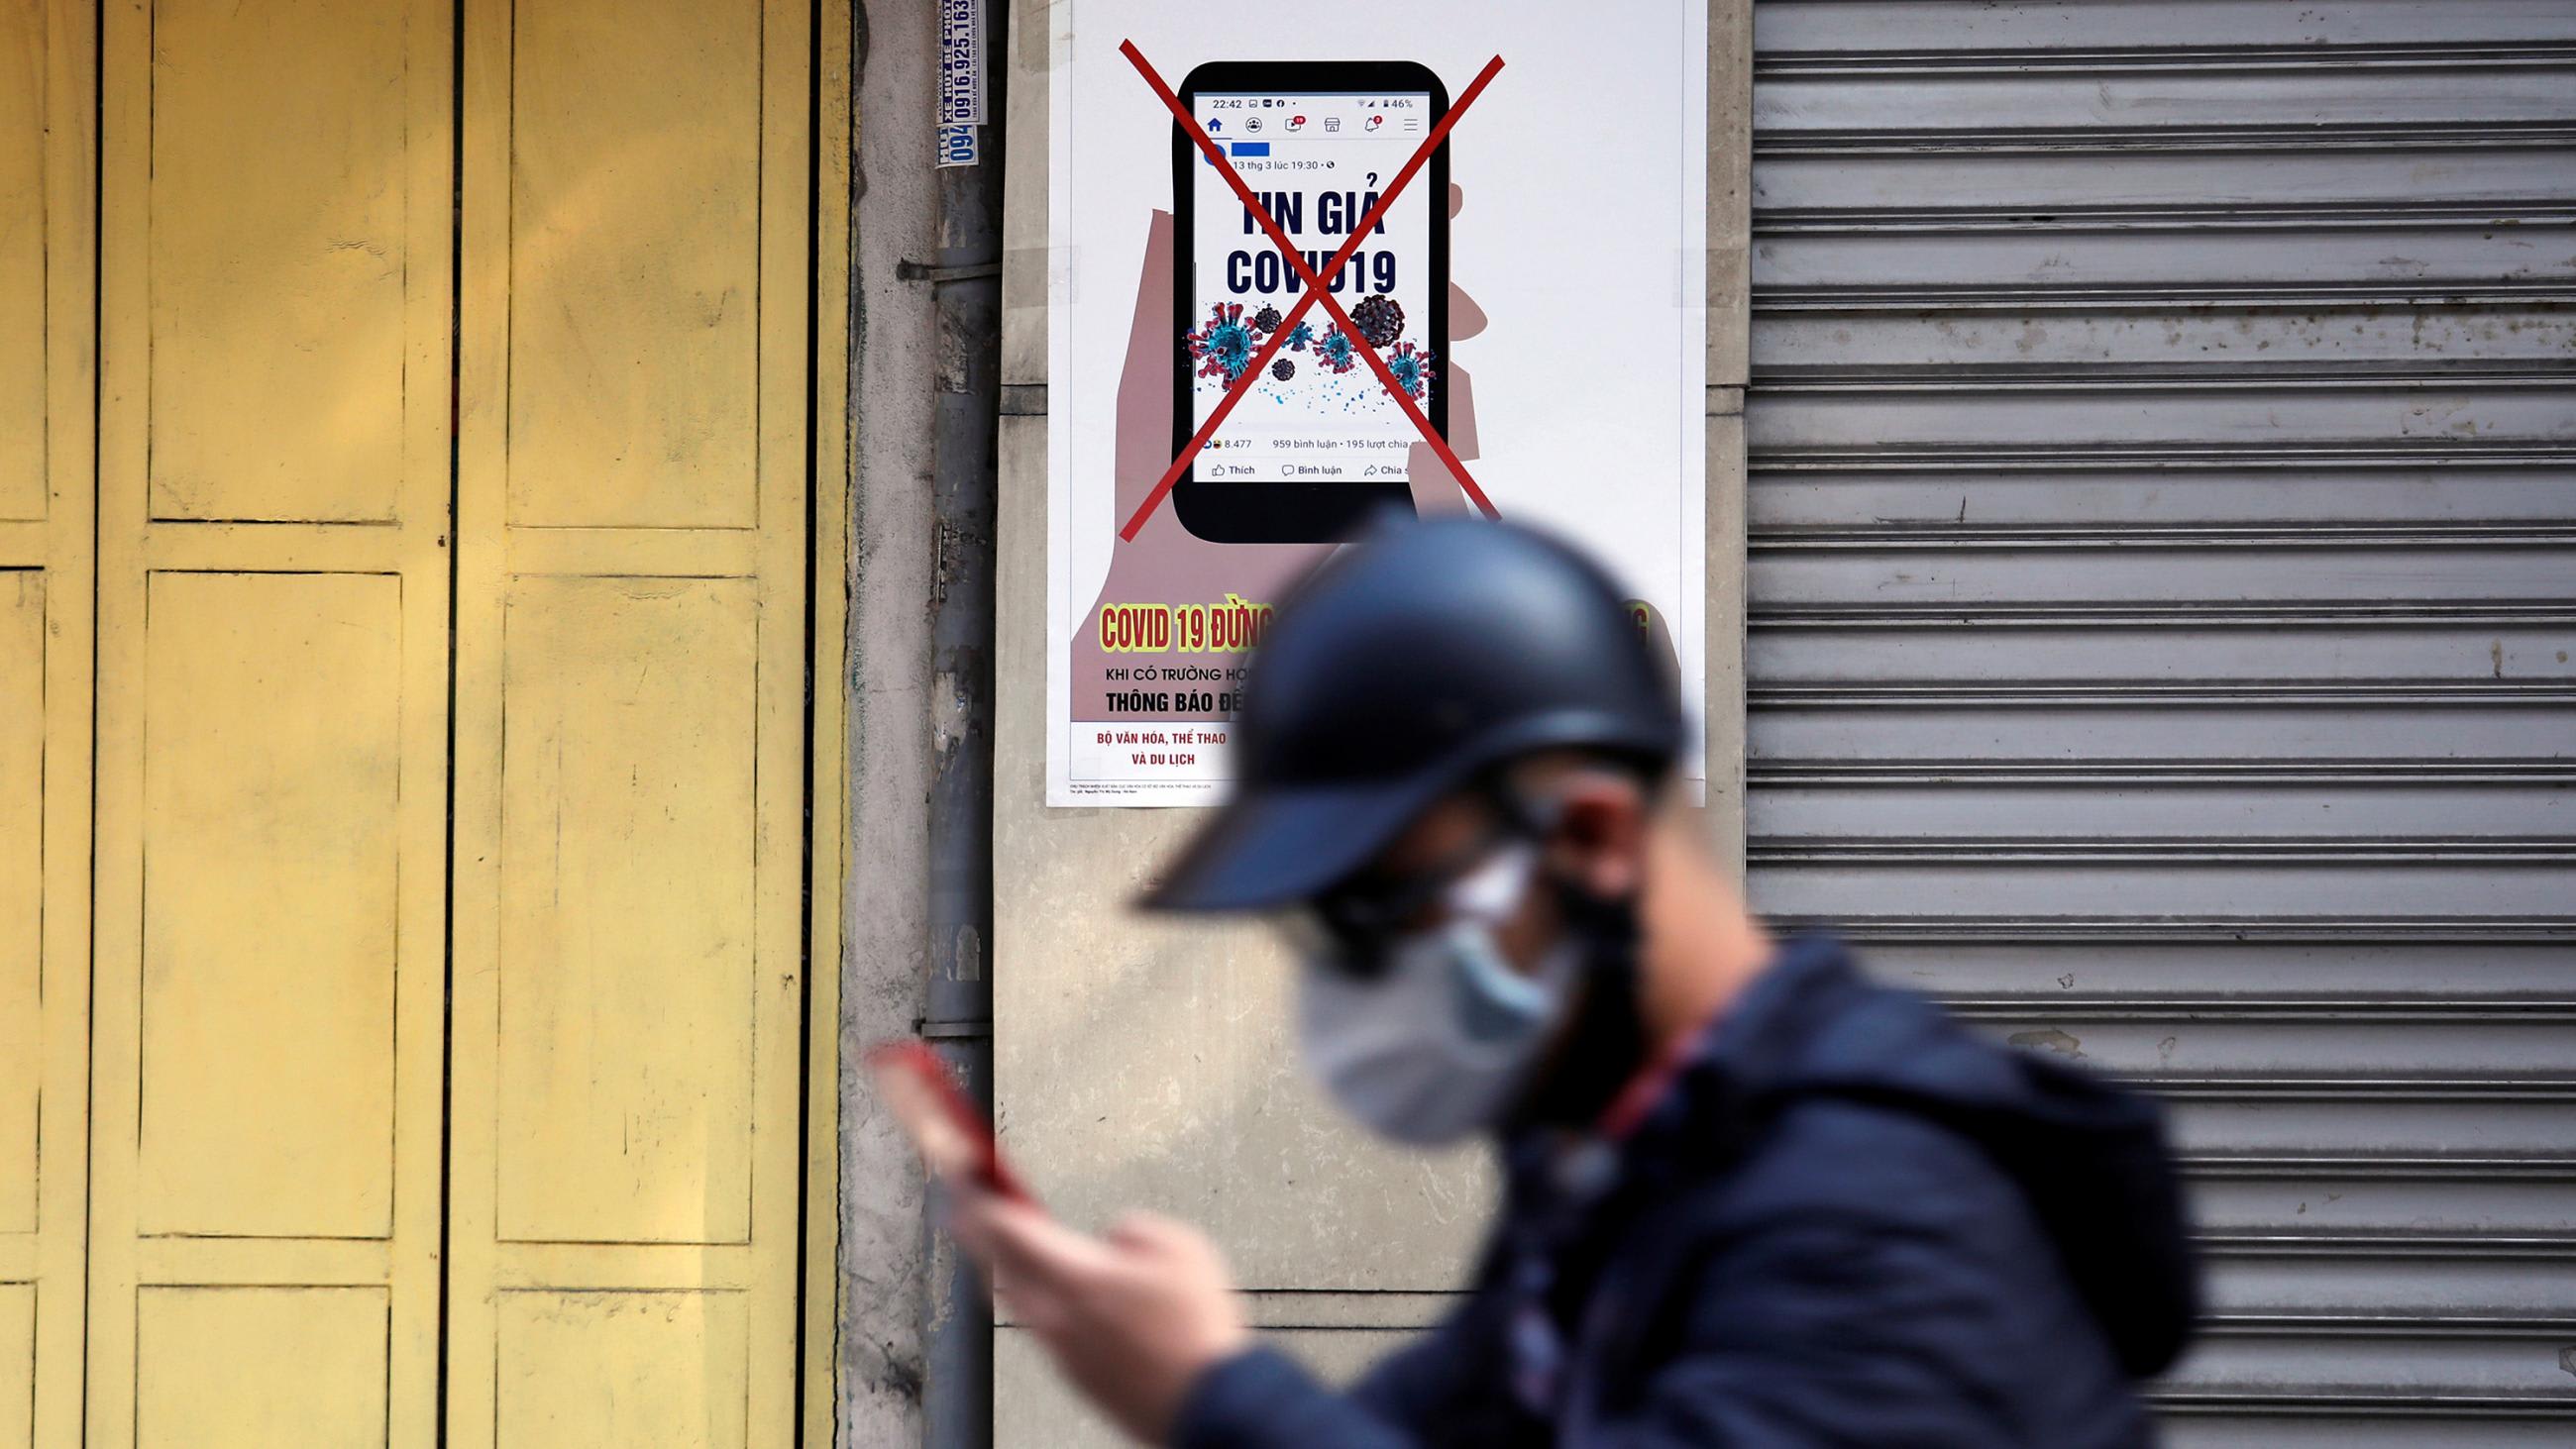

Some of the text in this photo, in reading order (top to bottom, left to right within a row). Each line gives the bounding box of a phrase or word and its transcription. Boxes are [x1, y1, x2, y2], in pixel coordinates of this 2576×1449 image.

[953, 0, 971, 118] 0916.925.163
[1213, 100, 1242, 109] 22:42
[1391, 99, 1413, 108] 46%
[1234, 160, 1319, 171] 13 thg 3 lúc 19:30
[1237, 171, 1386, 235] TIN GIẢ
[1225, 440, 1252, 449] 8.477
[1272, 440, 1291, 449] 959
[1293, 439, 1315, 449] bình
[1346, 440, 1364, 449] 195
[1388, 440, 1408, 449] chia
[1229, 466, 1255, 474] Thích
[1298, 466, 1342, 475] Bình luận
[1380, 466, 1402, 474] Chia
[1101, 606, 1170, 650] COVID
[1176, 606, 1205, 650] 19
[1106, 665, 1253, 683] KHI CÓ TRƯỜNG HỢ
[1106, 686, 1245, 712] THÔNG BÁO ĐẾ
[1097, 729, 1227, 746] BỘ VĂN HÓA, THỂ THAO
[1131, 751, 1195, 768] VÀ DU LỊCH
